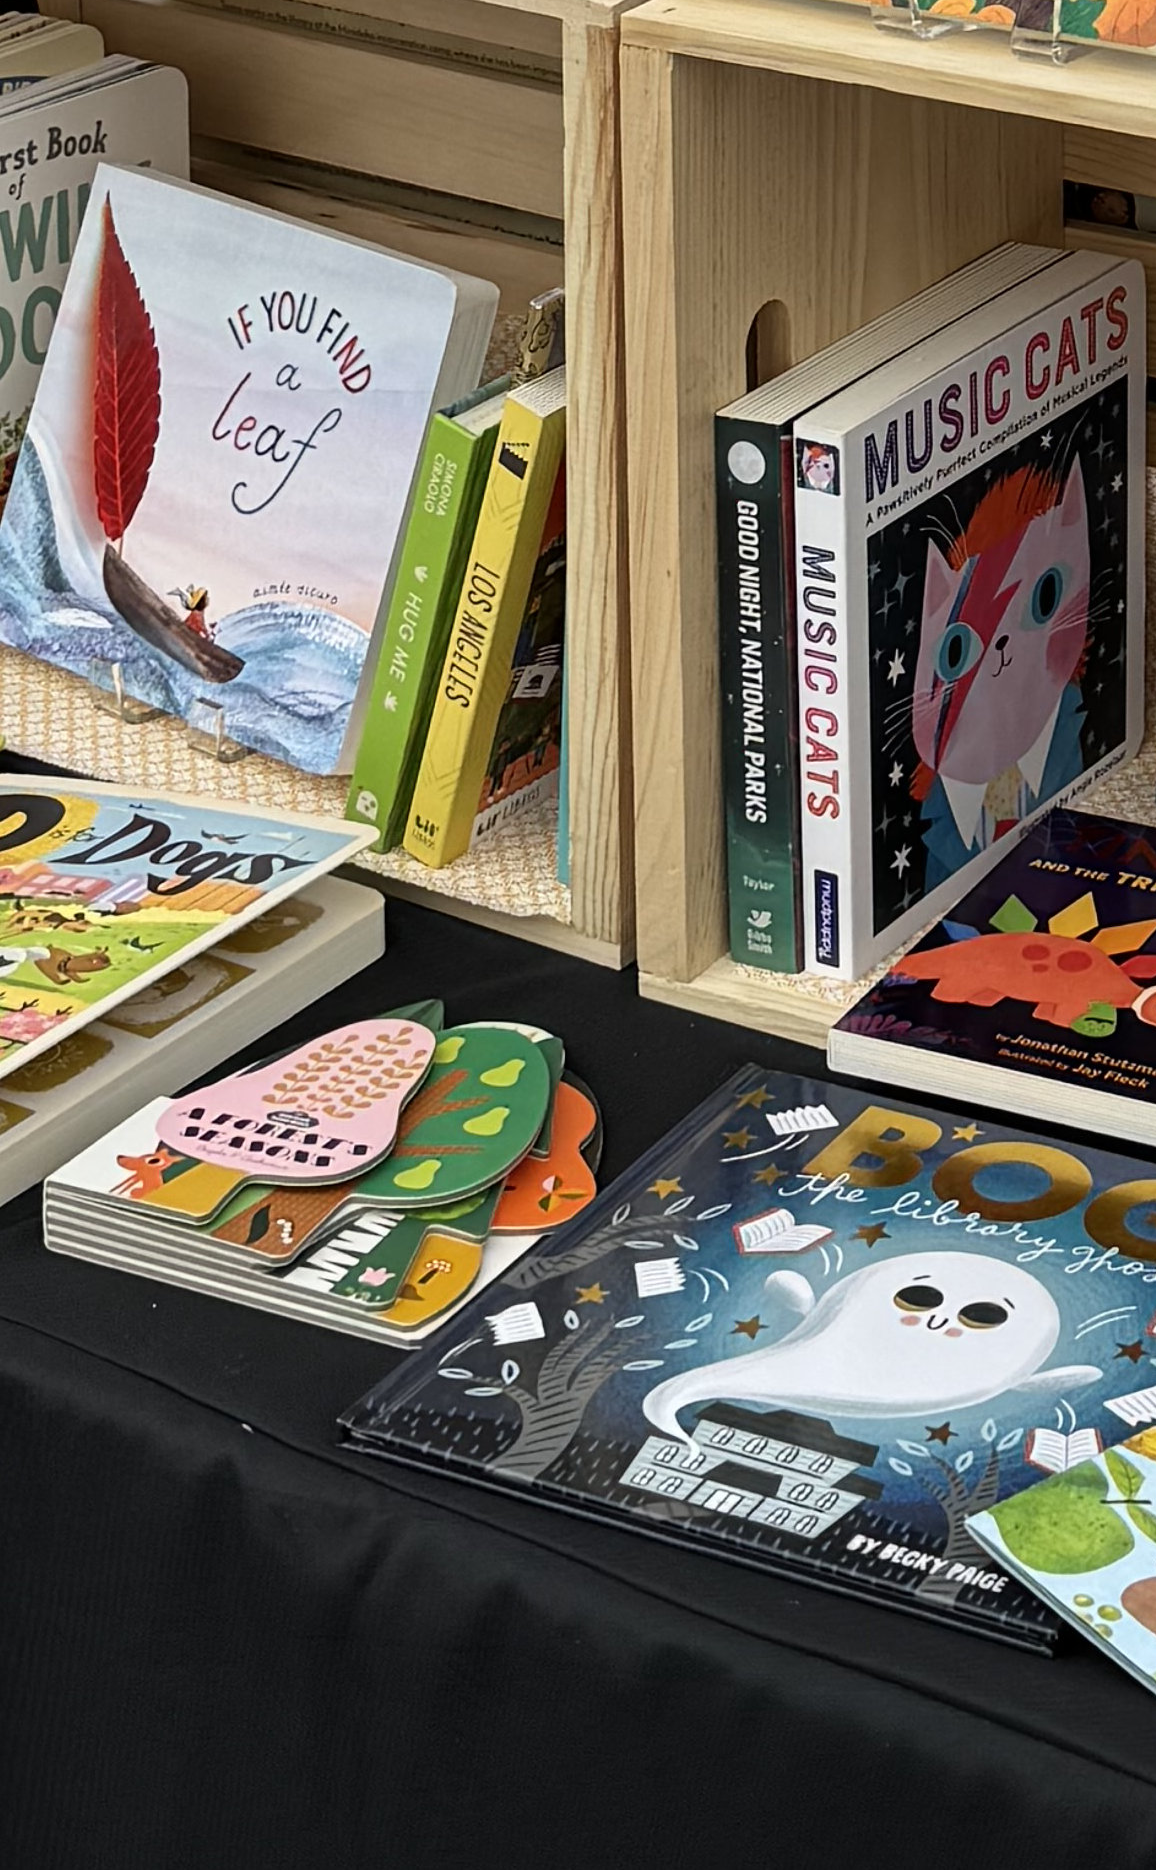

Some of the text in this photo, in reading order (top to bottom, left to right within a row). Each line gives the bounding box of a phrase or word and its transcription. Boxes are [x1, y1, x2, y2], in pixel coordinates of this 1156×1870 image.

[46, 121, 108, 161] Book
[9, 174, 26, 200] of
[227, 291, 371, 394] IF YOU FIND
[276, 364, 301, 391] a
[864, 286, 1129, 503] MUSIC CATS
[212, 372, 342, 515] leaf
[936, 355, 1128, 482] Purrfect of Musical Legends
[423, 452, 445, 514] CIRAOLO
[436, 460, 458, 517] SIMONA
[389, 591, 424, 683] HUG ME
[445, 562, 501, 708] LOS ANGELES
[737, 500, 767, 824] GOOD NIGHT, NATIONAL PARKS
[802, 546, 840, 821] MUSIC CATS
[52, 813, 318, 896] Dogs
[742, 874, 775, 891] Taylor
[1028, 857, 1071, 878] AND
[1074, 866, 1108, 882] THE
[1010, 1034, 1088, 1060] Jonathan
[1072, 1063, 1149, 1089] Jay Fleck
[871, 1192, 1064, 1262] library
[846, 1534, 1009, 1593] BY BECKY PAIGE
